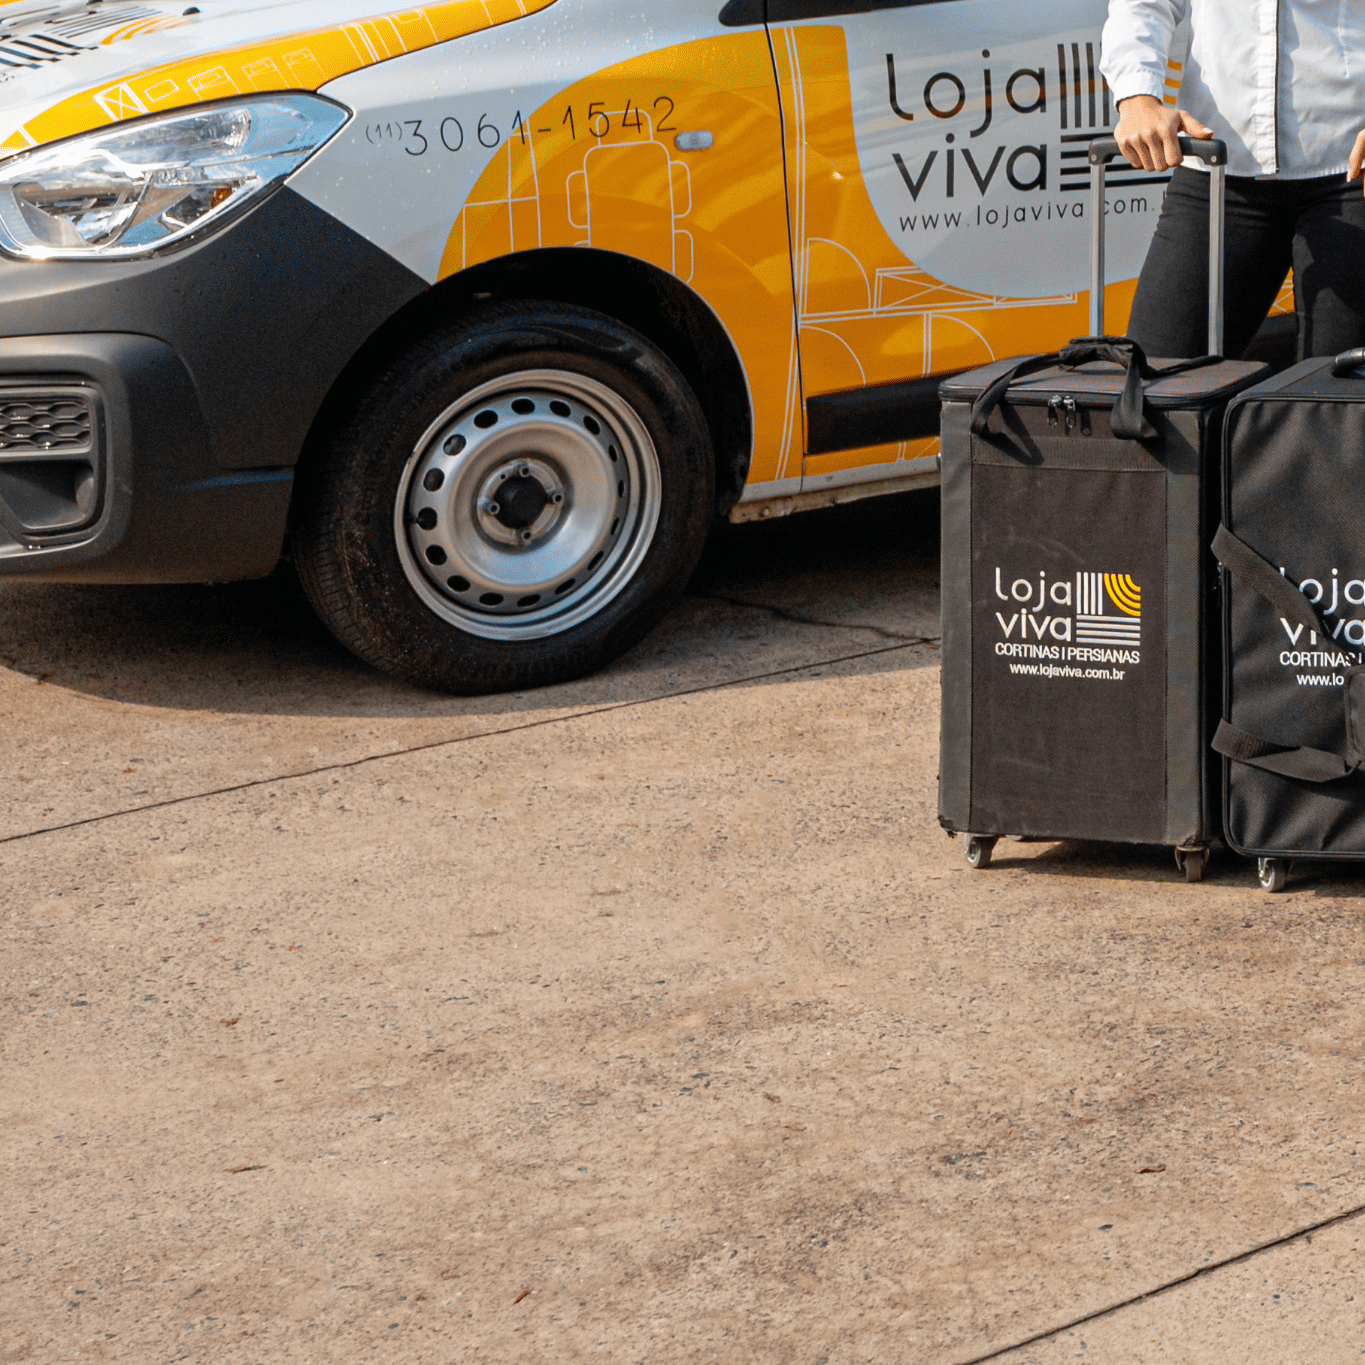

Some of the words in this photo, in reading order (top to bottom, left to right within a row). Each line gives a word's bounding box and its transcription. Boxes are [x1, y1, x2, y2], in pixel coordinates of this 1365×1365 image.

[886, 49, 1047, 138] loja
[892, 132, 1047, 203] viva
[995, 567, 1072, 613] loja
[995, 607, 1072, 642] viva
[995, 642, 1060, 660] CORTINAS
[1067, 646, 1141, 664] PERSIANAS
[1009, 662, 1126, 680] www.lojaviva.com.br
